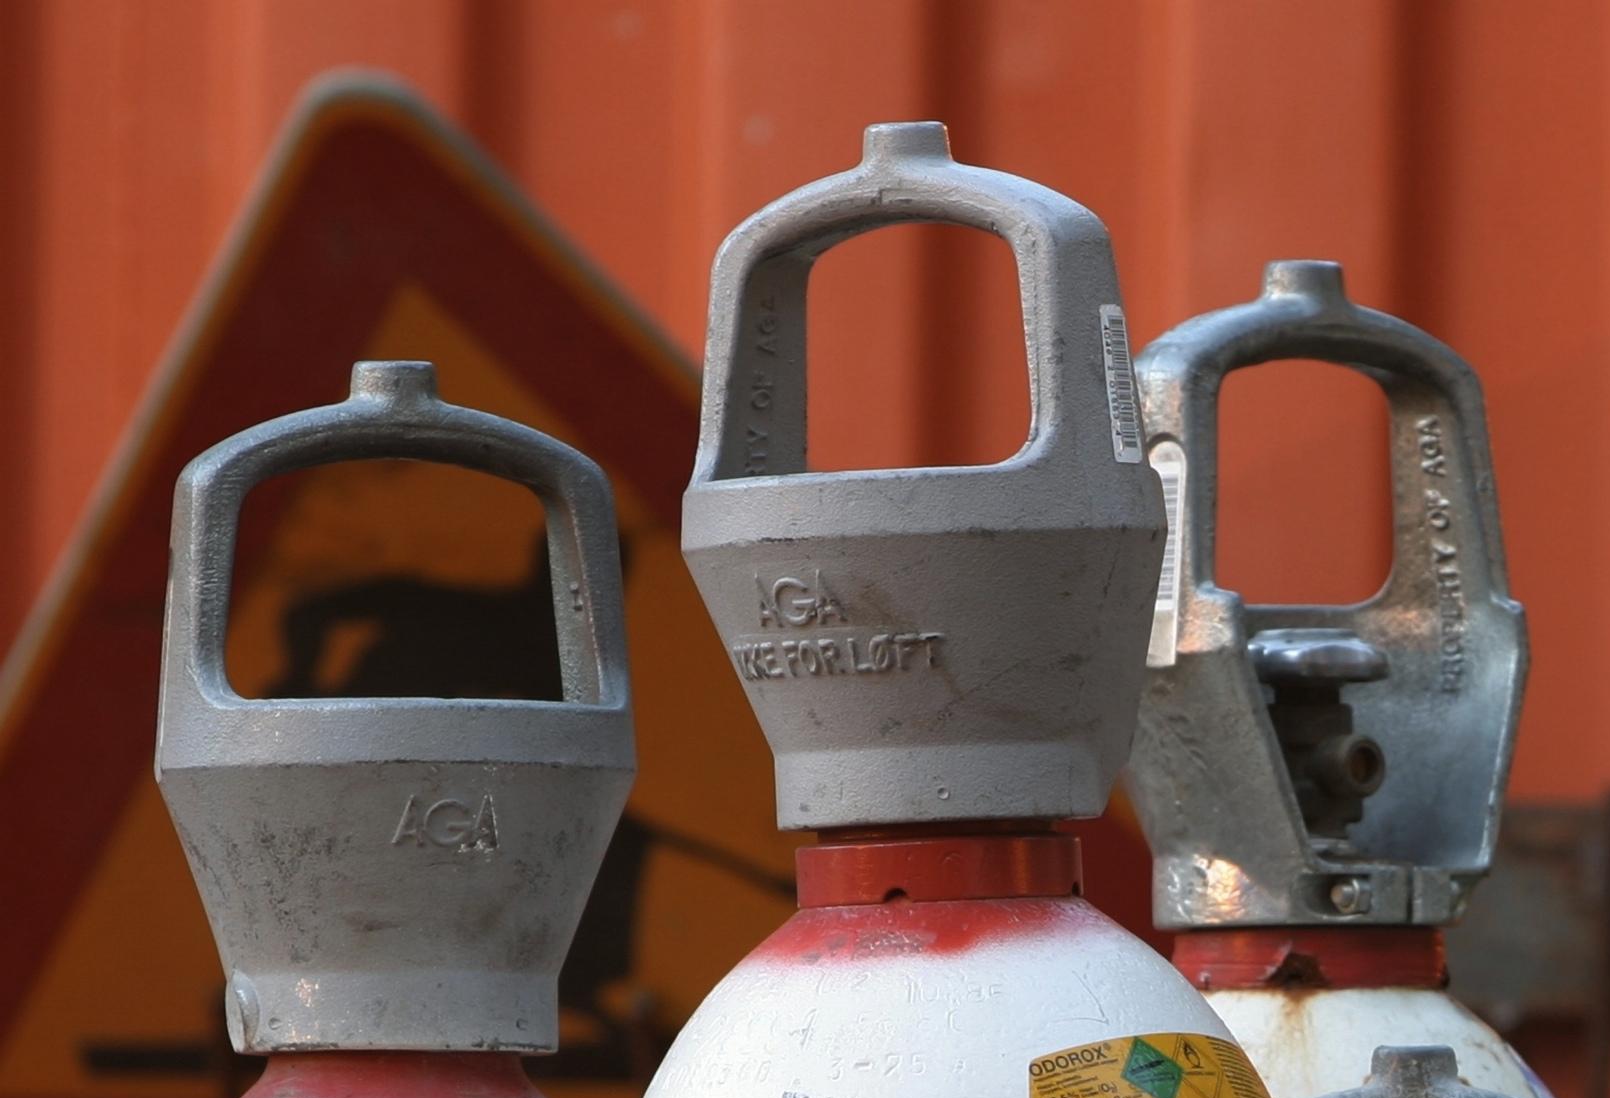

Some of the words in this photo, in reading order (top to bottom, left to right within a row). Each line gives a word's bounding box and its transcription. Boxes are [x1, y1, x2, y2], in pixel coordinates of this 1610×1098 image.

[1414, 414, 1447, 477] AGA
[1425, 488, 1450, 530] OF
[754, 569, 848, 627] AGA
[392, 793, 499, 850] AGA
